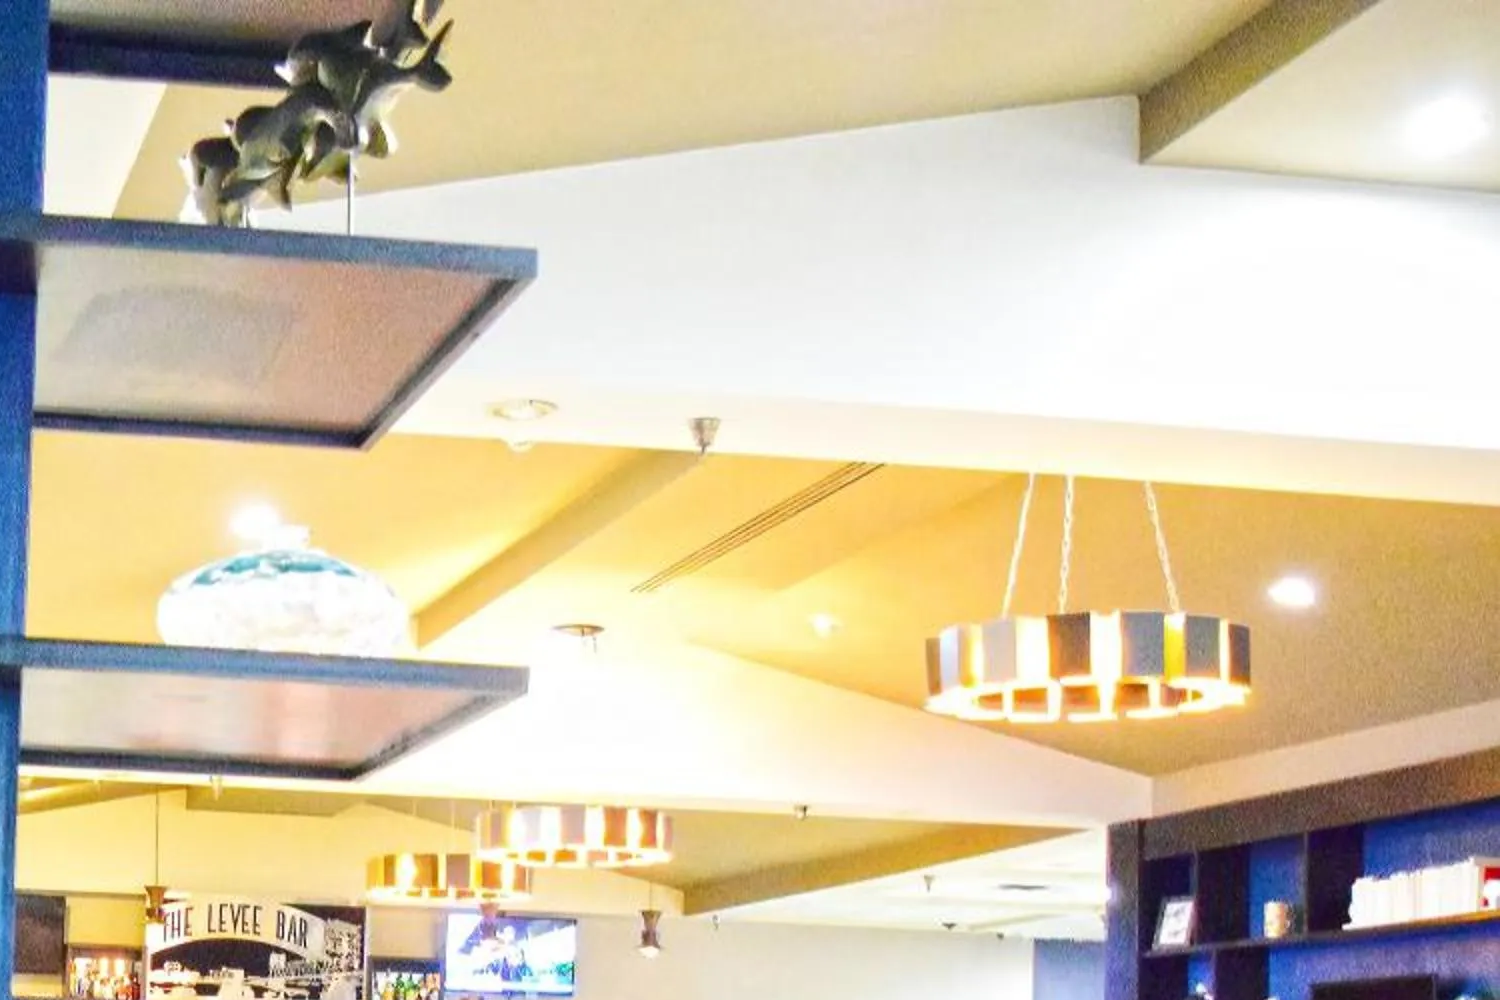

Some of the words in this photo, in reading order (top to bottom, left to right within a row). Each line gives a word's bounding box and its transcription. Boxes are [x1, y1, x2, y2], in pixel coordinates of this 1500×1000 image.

[163, 907, 194, 943] THE
[207, 903, 263, 936] LEVEE
[276, 909, 309, 949] BAR
